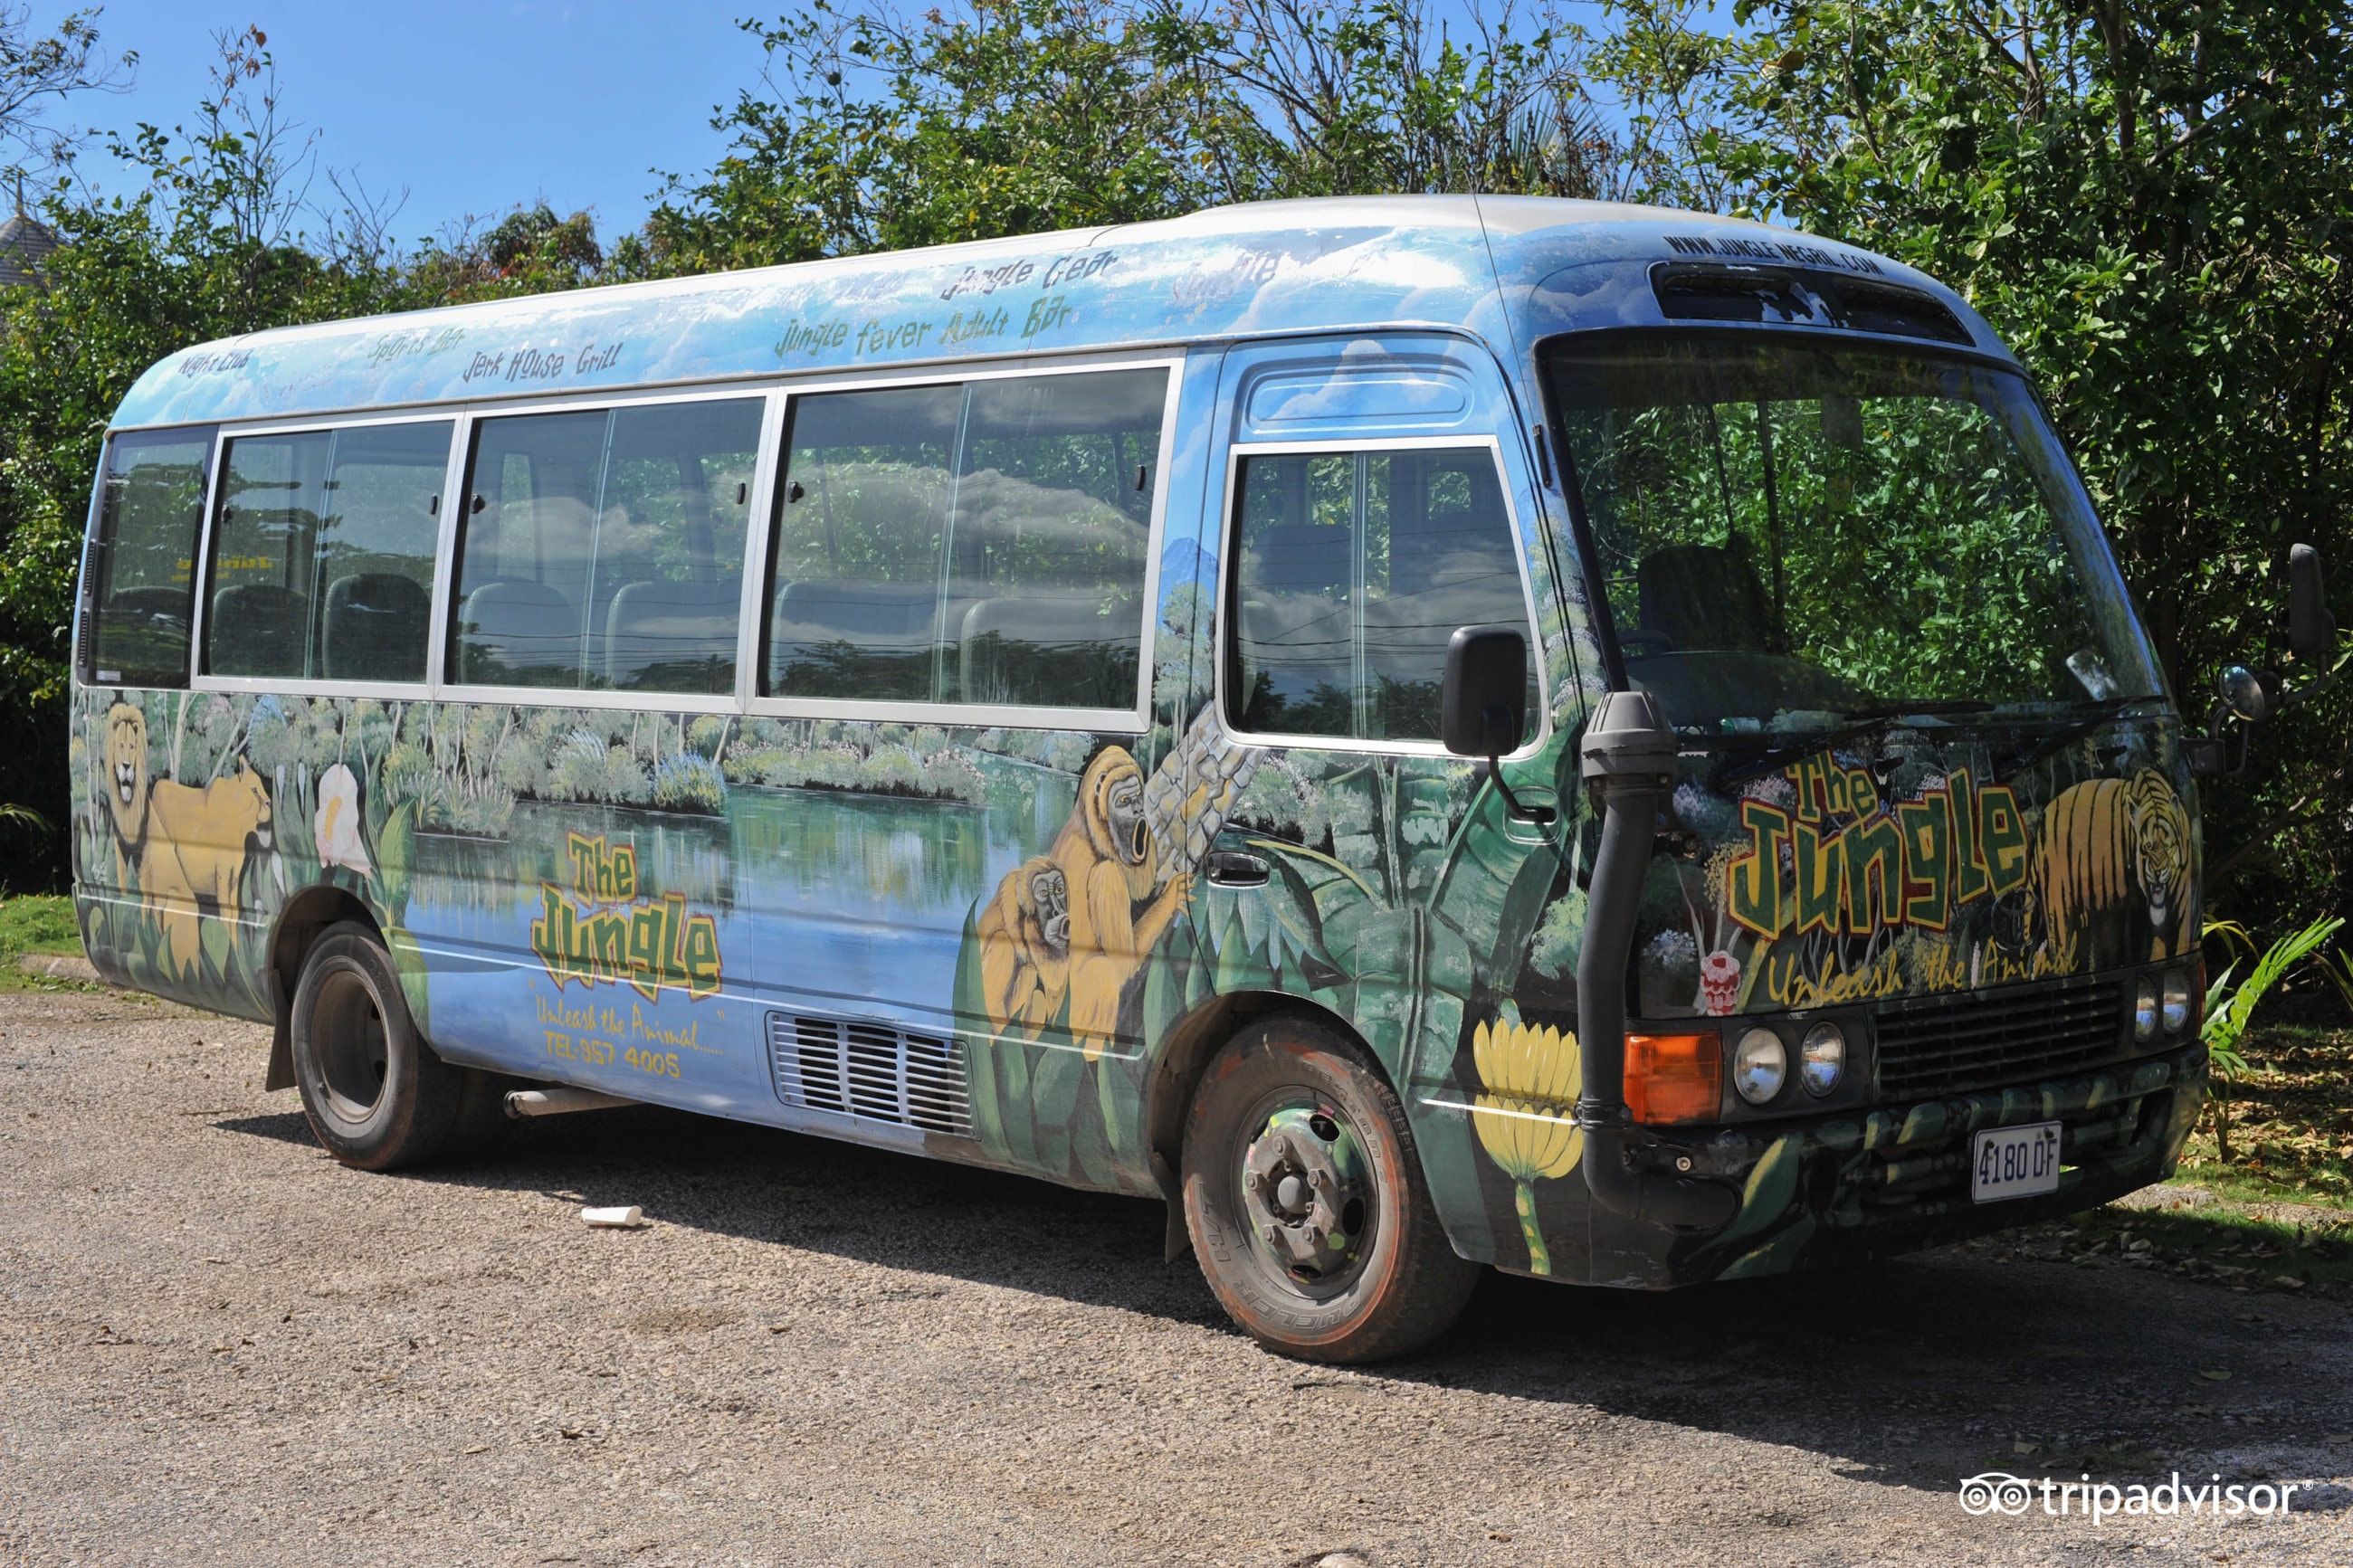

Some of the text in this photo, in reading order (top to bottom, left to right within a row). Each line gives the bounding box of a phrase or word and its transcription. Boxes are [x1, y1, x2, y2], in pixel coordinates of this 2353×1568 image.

[1041, 249, 1120, 290] Gear
[855, 318, 933, 356] fever
[938, 306, 1010, 346] Adult
[1019, 293, 1074, 341] Bar
[462, 349, 504, 384] Jerk
[575, 341, 624, 375] Grill
[1786, 749, 1881, 822] The
[567, 829, 638, 908] The
[1725, 766, 2030, 942] Jungle
[530, 879, 724, 1005] Jungle
[1767, 949, 1904, 1006] Unleash
[1925, 943, 1965, 992] the
[600, 1006, 625, 1039] the
[624, 1045, 682, 1079] 4005
[1978, 1136, 2057, 1185] 4180 DF
